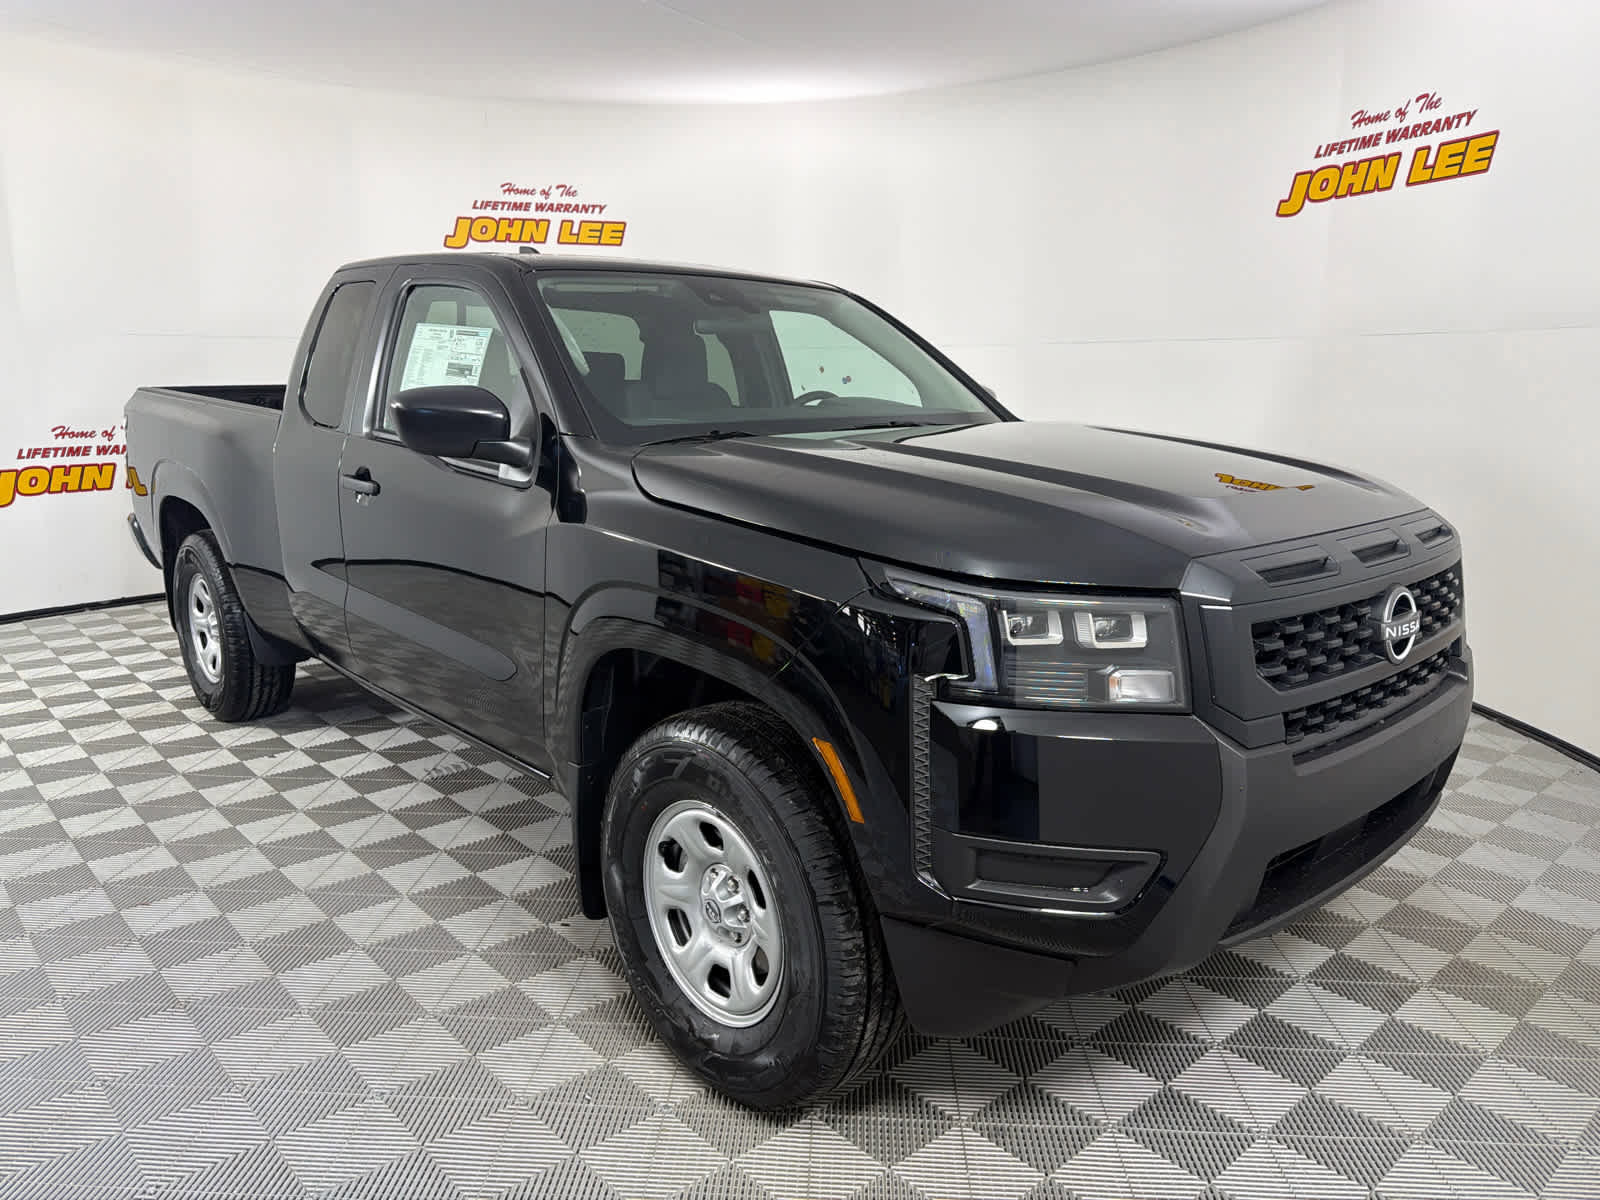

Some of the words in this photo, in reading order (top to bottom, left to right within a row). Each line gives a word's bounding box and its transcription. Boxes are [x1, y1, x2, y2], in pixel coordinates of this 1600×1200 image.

[1351, 110, 1391, 129] Home
[1395, 99, 1411, 123] of
[1415, 91, 1442, 114] The
[1314, 132, 1384, 159] LIFETIME
[1385, 109, 1478, 144] WARRANTY
[1276, 152, 1402, 217] JOHN
[1405, 130, 1500, 187] LEE
[472, 199, 532, 212] LIFETIME
[535, 202, 607, 215] WARRANTY
[500, 182, 536, 197] Home
[539, 184, 552, 200] of
[556, 184, 578, 198] The
[443, 216, 551, 249] JOHN
[557, 219, 627, 247] LEE
[51, 425, 97, 440] Home
[101, 424, 116, 442] of
[17, 445, 92, 459] LIFETIME
[0, 463, 117, 508] JOHN
